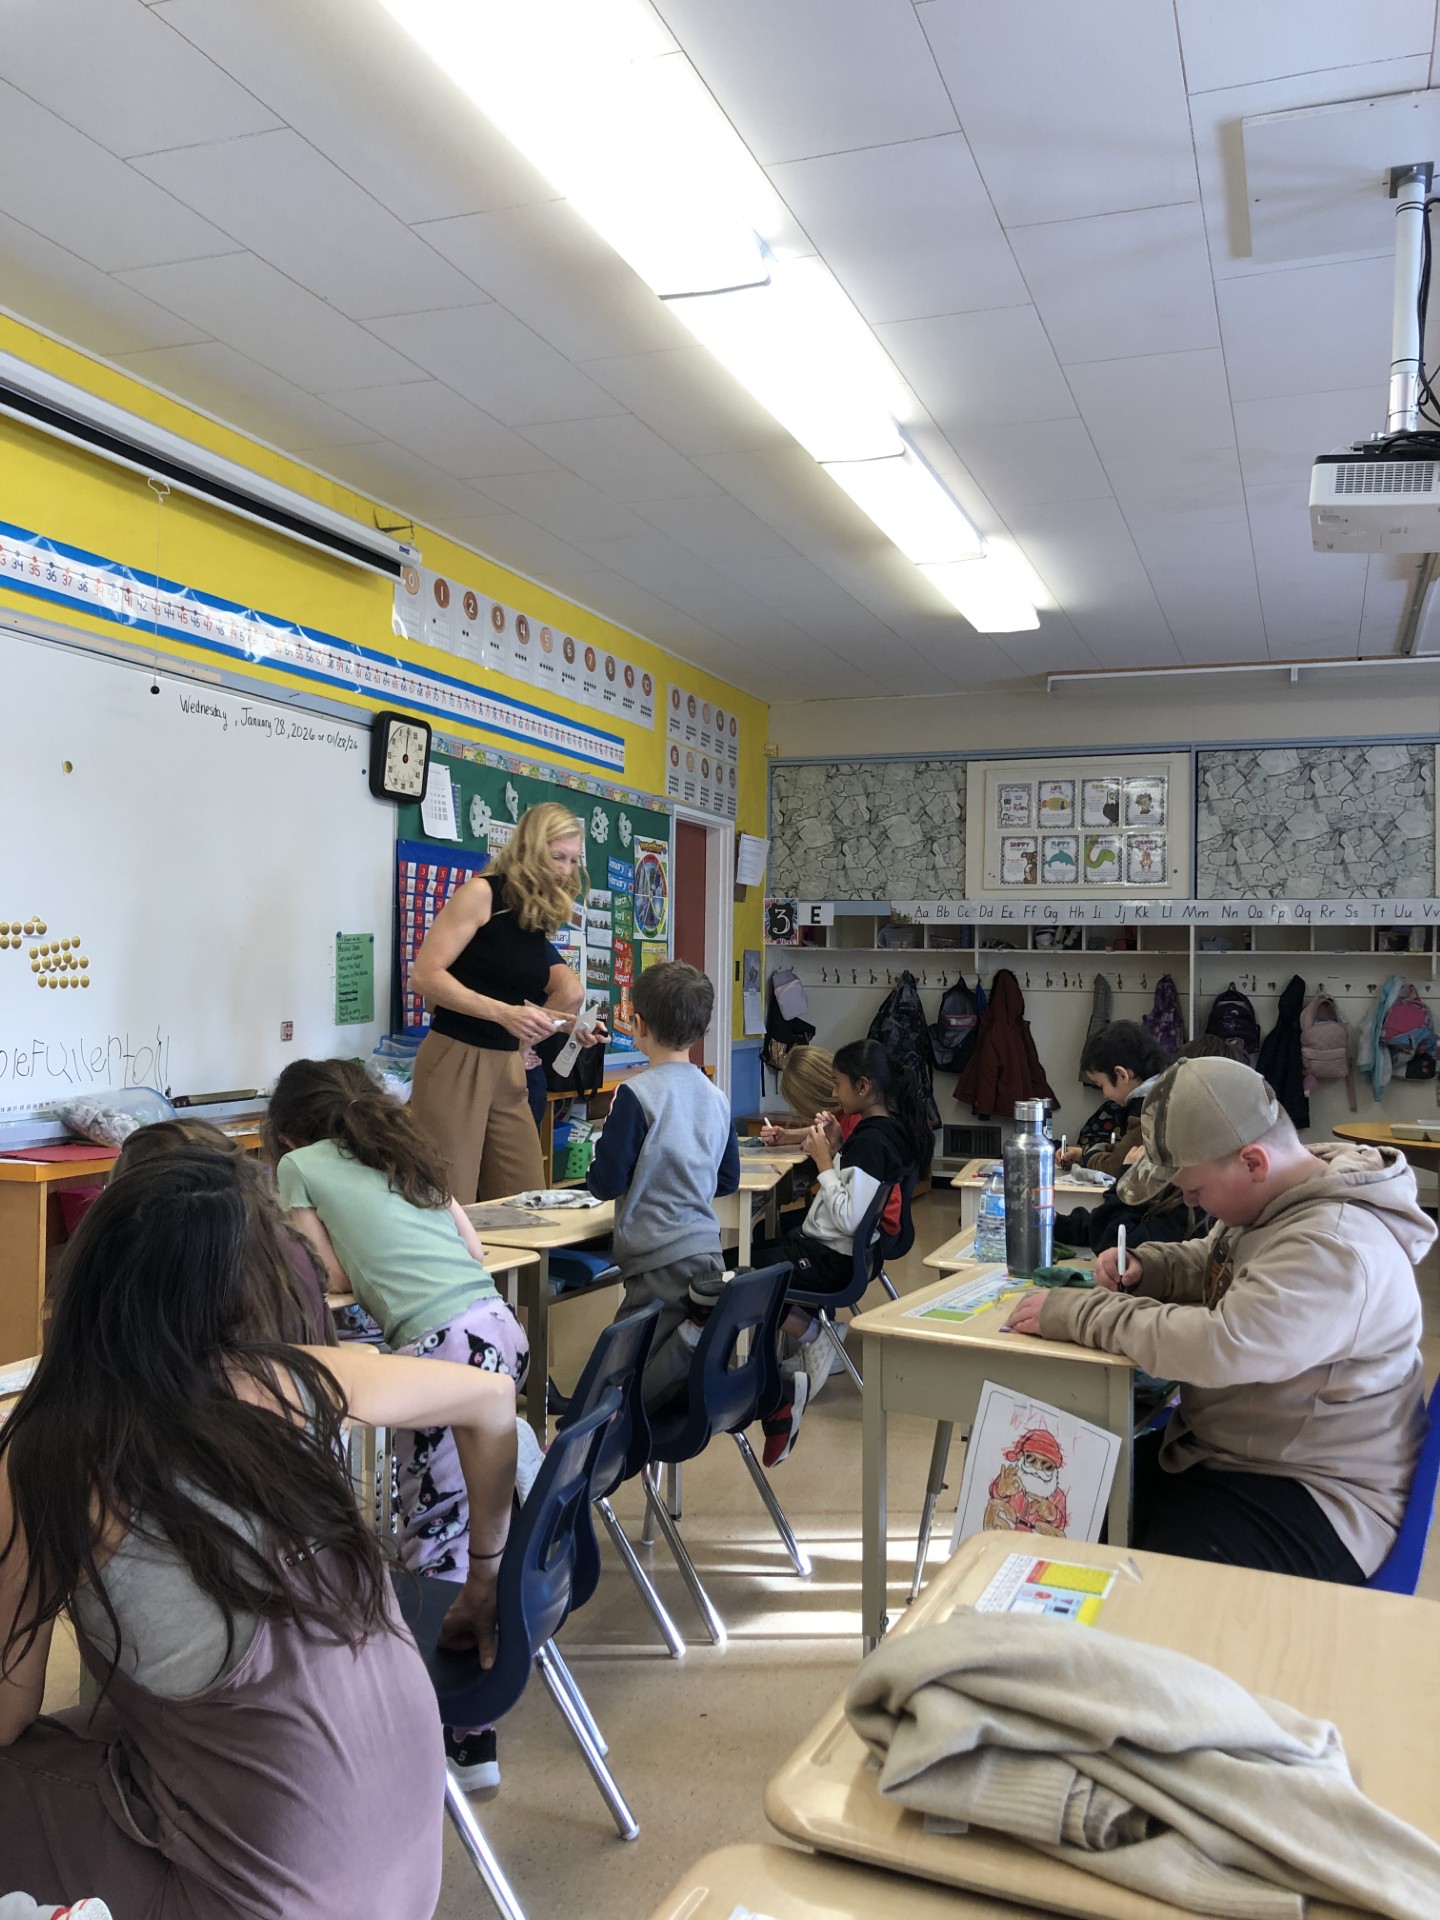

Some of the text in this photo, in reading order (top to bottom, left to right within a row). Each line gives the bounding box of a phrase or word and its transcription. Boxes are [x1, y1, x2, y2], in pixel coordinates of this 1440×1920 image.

[12, 558, 23, 572] 34
[29, 563, 41, 577] 35
[46, 568, 57, 582] 36
[62, 574, 73, 587] 37
[125, 595, 132, 607] 41
[137, 598, 147, 611] 42
[164, 607, 174, 620] 44
[178, 612, 188, 624] 45
[191, 616, 200, 628] 46
[203, 619, 213, 631] 47
[296, 649, 303, 660] 55
[306, 652, 314, 663] 56
[336, 661, 343, 672] 59
[356, 667, 361, 677] 61
[365, 671, 371, 681] 62
[374, 674, 380, 684] 63
[383, 675, 390, 686] 64
[401, 682, 407, 691] 66
[417, 685, 423, 696] 68
[409, 573, 650, 691] 0 1 2 3 4 5 6 7 8 9 10
[240, 707, 272, 737] January
[291, 723, 315, 740] 2026
[772, 906, 822, 935] 3 E
[914, 906, 929, 918] Aa
[936, 905, 950, 918] Bb
[957, 905, 970, 918] Cc
[979, 905, 993, 918] Dd
[1001, 905, 1013, 918] Ee
[1023, 905, 1037, 918] Ff
[1043, 905, 1058, 924] Gg
[1069, 905, 1084, 918] Hh
[1092, 905, 1102, 918] Ii
[1114, 905, 1126, 924] Jj
[1135, 905, 1149, 918] Kk
[1182, 905, 1209, 918] Mm
[1221, 905, 1238, 918] Nn
[1247, 905, 1263, 918] Oo
[1271, 904, 1285, 923] Pp
[1294, 904, 1311, 924] Qq
[1320, 905, 1335, 918] Rr
[1345, 904, 1358, 918] Ss
[1371, 904, 1386, 918] Tt
[1395, 904, 1413, 918] Uu
